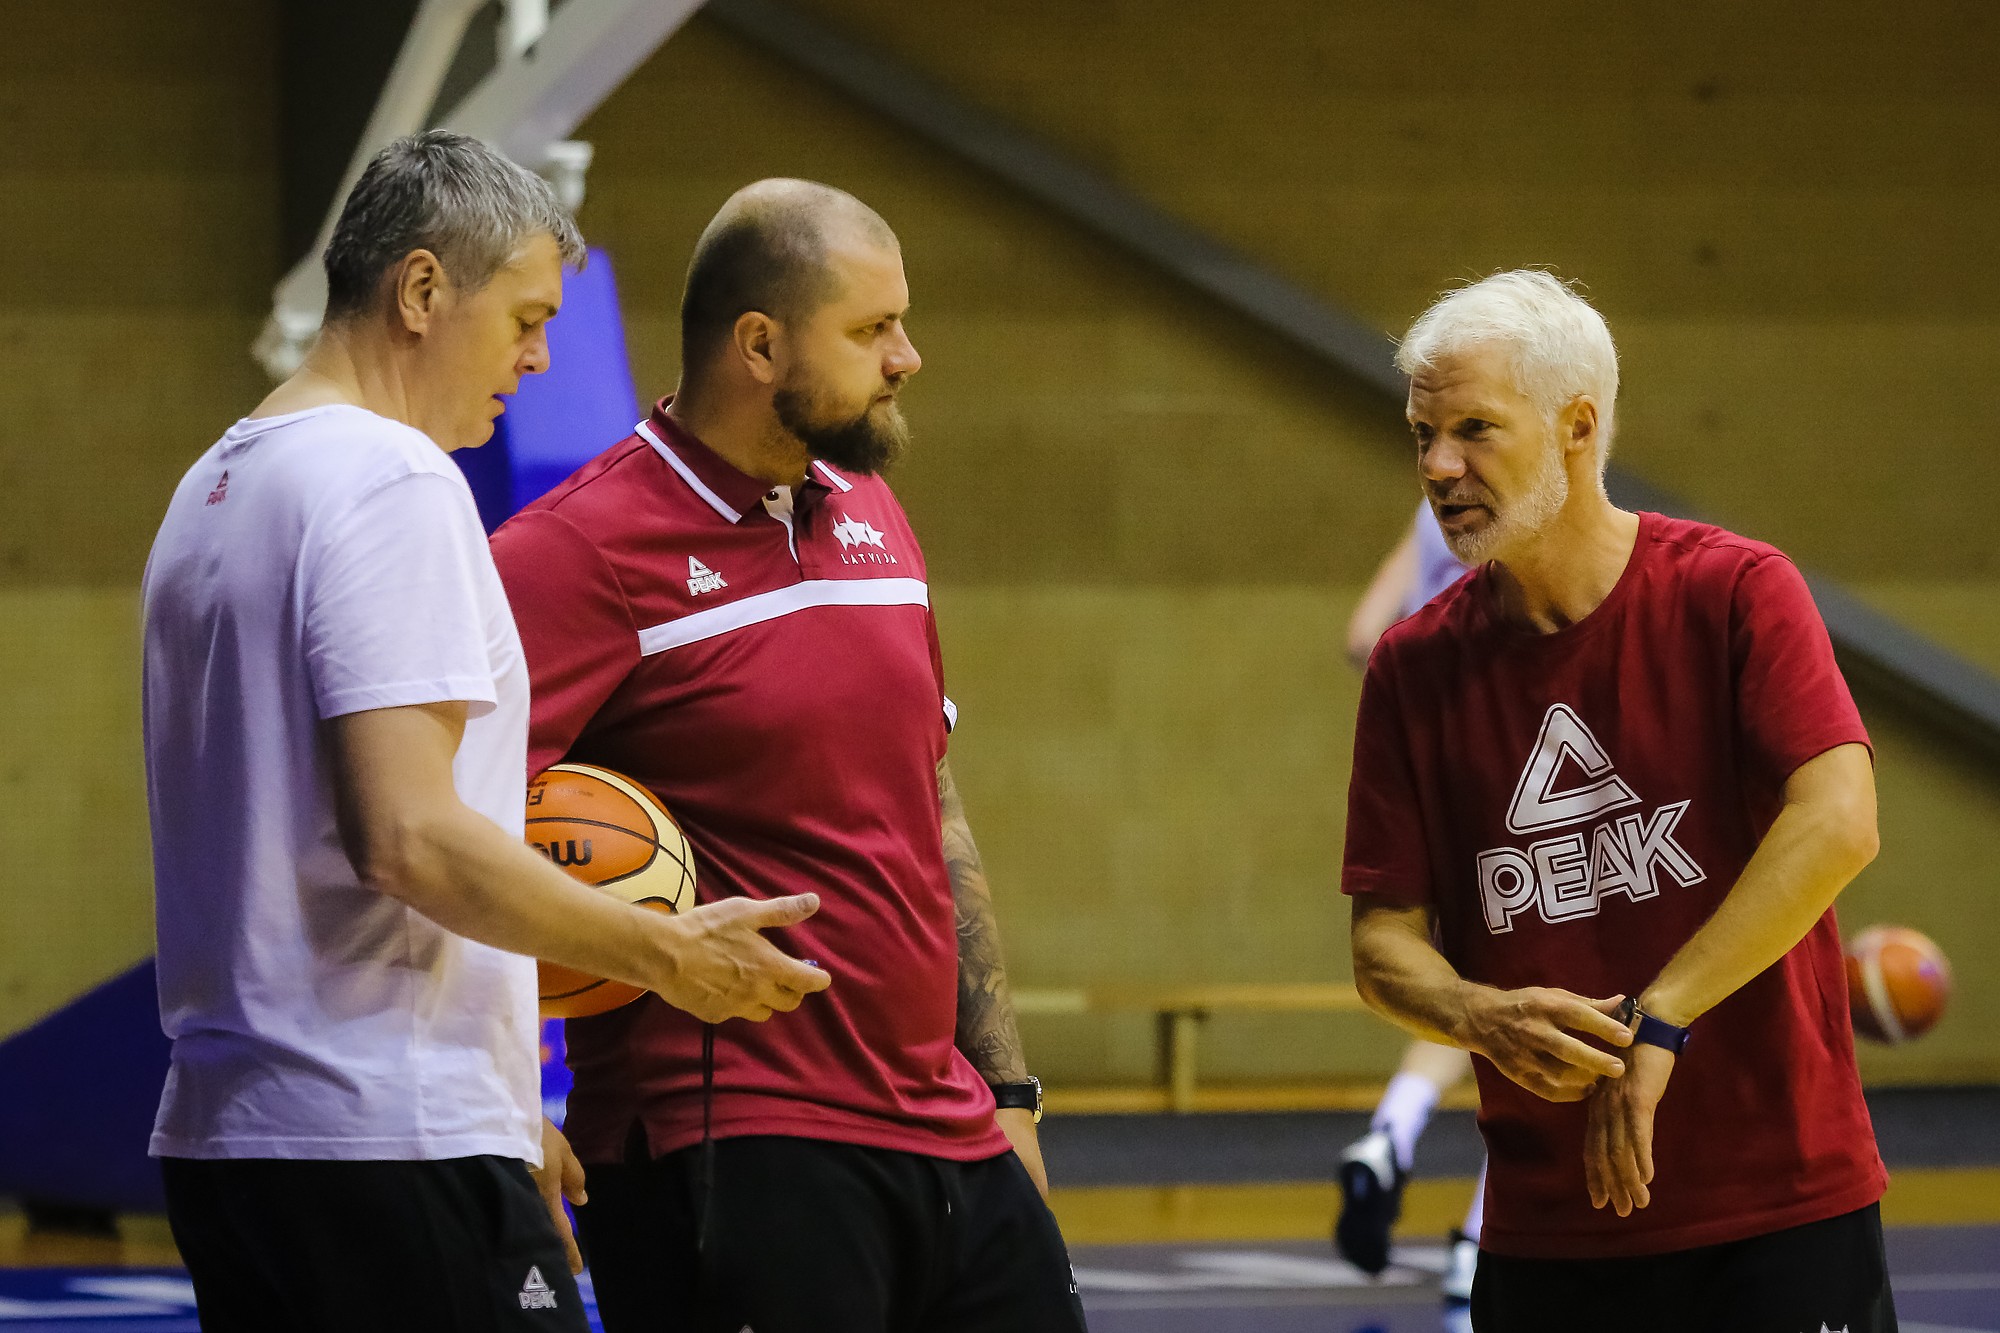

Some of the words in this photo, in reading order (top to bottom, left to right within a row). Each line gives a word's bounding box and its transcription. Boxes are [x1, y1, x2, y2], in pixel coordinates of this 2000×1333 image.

[840, 552, 898, 565] LATVIJA
[686, 571, 728, 597] PEAK
[1476, 799, 1708, 935] PEAK
[518, 1290, 558, 1310] PEAK
